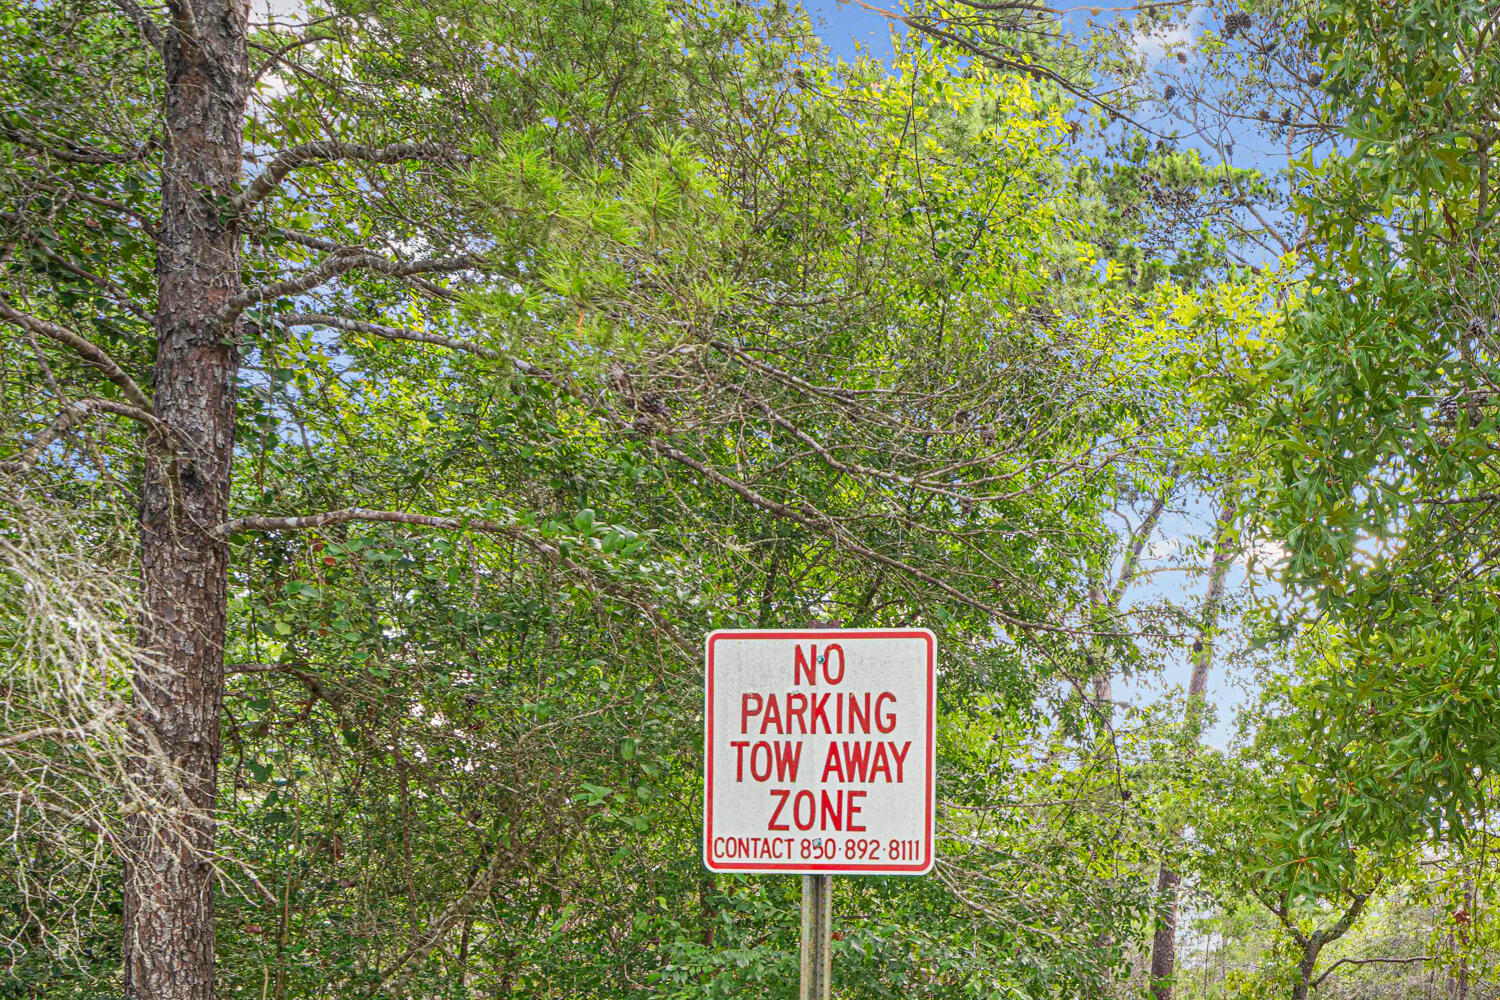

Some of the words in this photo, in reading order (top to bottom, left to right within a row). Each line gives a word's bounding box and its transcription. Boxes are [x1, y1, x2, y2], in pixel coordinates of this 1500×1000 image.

[794, 643, 846, 686] NO
[741, 691, 897, 735] PARKING
[730, 740, 803, 783] TOW
[821, 741, 912, 784] AWAY
[768, 789, 867, 832] ZONE
[714, 836, 794, 859] CONTACT
